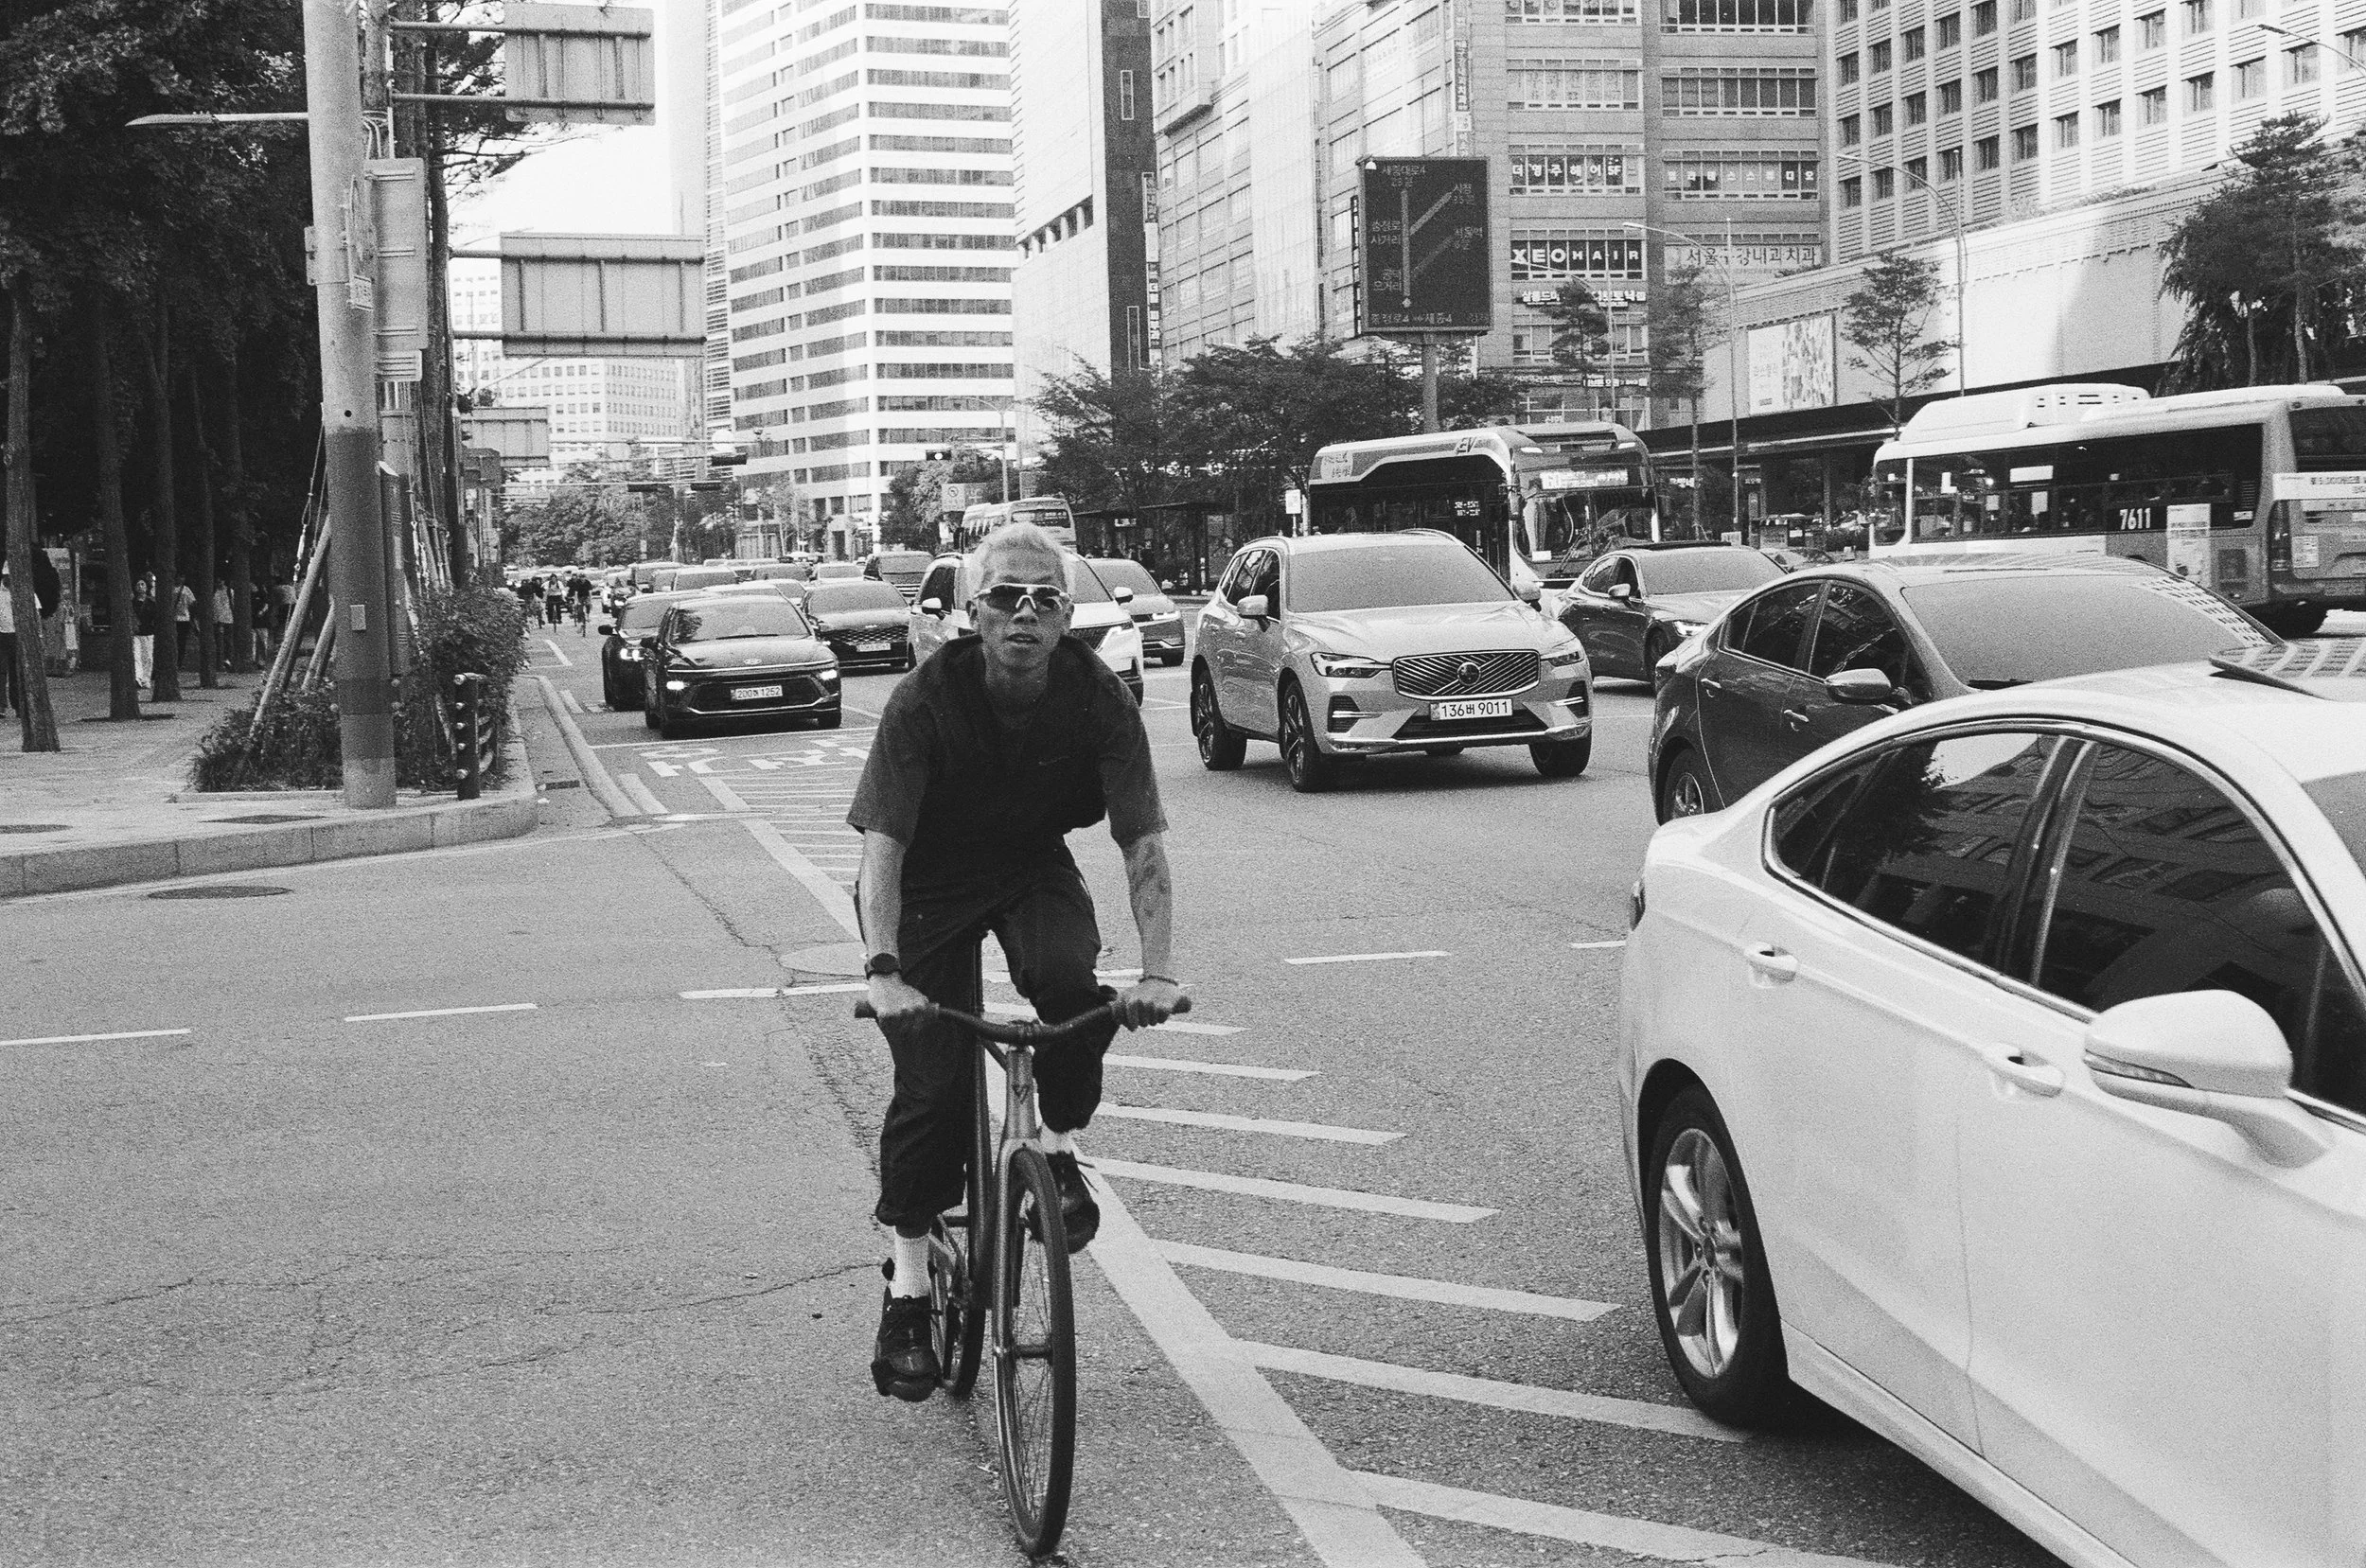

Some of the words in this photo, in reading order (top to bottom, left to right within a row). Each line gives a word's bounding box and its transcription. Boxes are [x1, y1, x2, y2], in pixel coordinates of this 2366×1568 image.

[1457, 436, 1477, 455] EV
[2118, 507, 2151, 530] 7611
[761, 686, 781, 696] 1252
[1441, 703, 1475, 718] 136버
[1478, 700, 1509, 715] 9011
